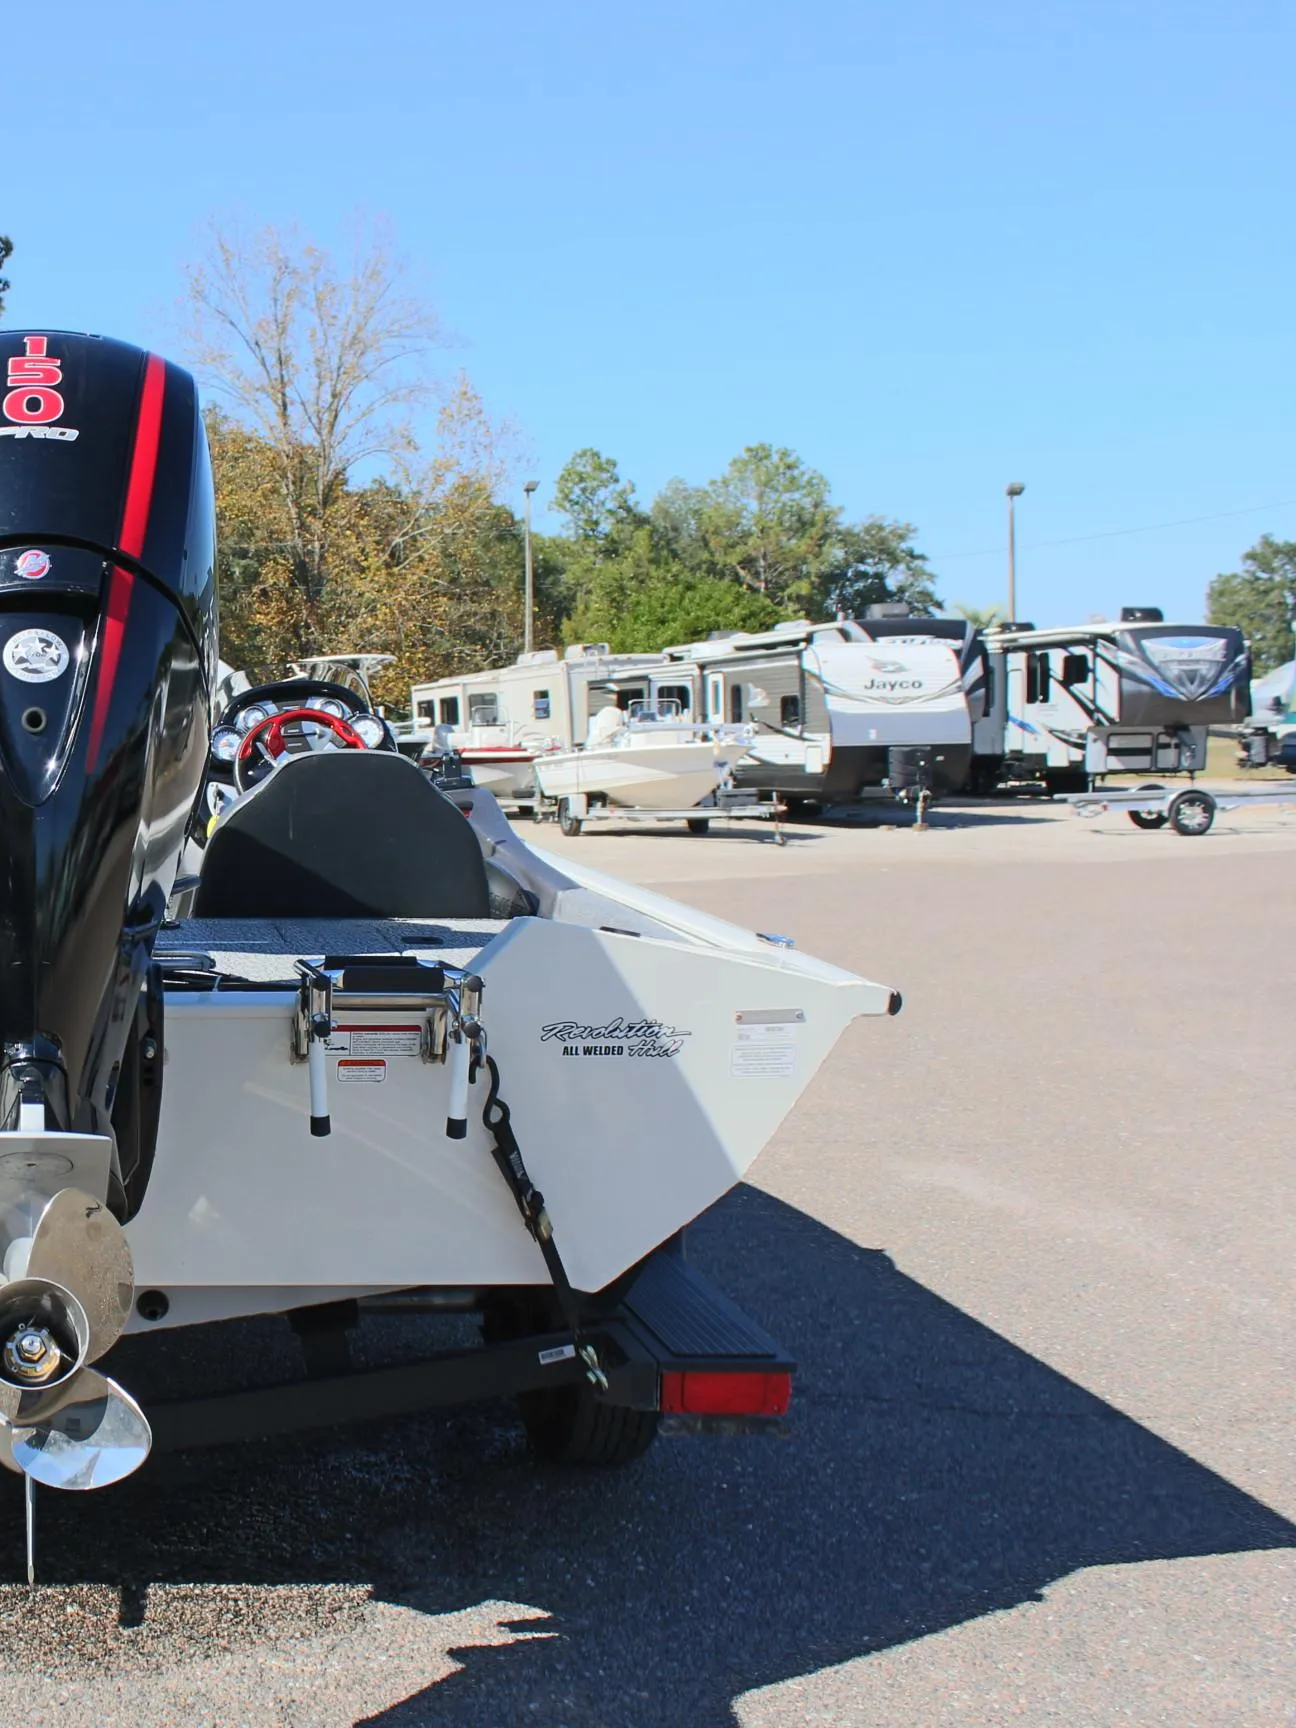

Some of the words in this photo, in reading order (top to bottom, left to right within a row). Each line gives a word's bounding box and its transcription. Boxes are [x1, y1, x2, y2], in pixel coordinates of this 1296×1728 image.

[3, 336, 64, 424] 150
[864, 679, 923, 691] Jayco
[540, 1016, 692, 1042] Revolution
[562, 1046, 580, 1056] ALL
[582, 1045, 624, 1056] WELDED
